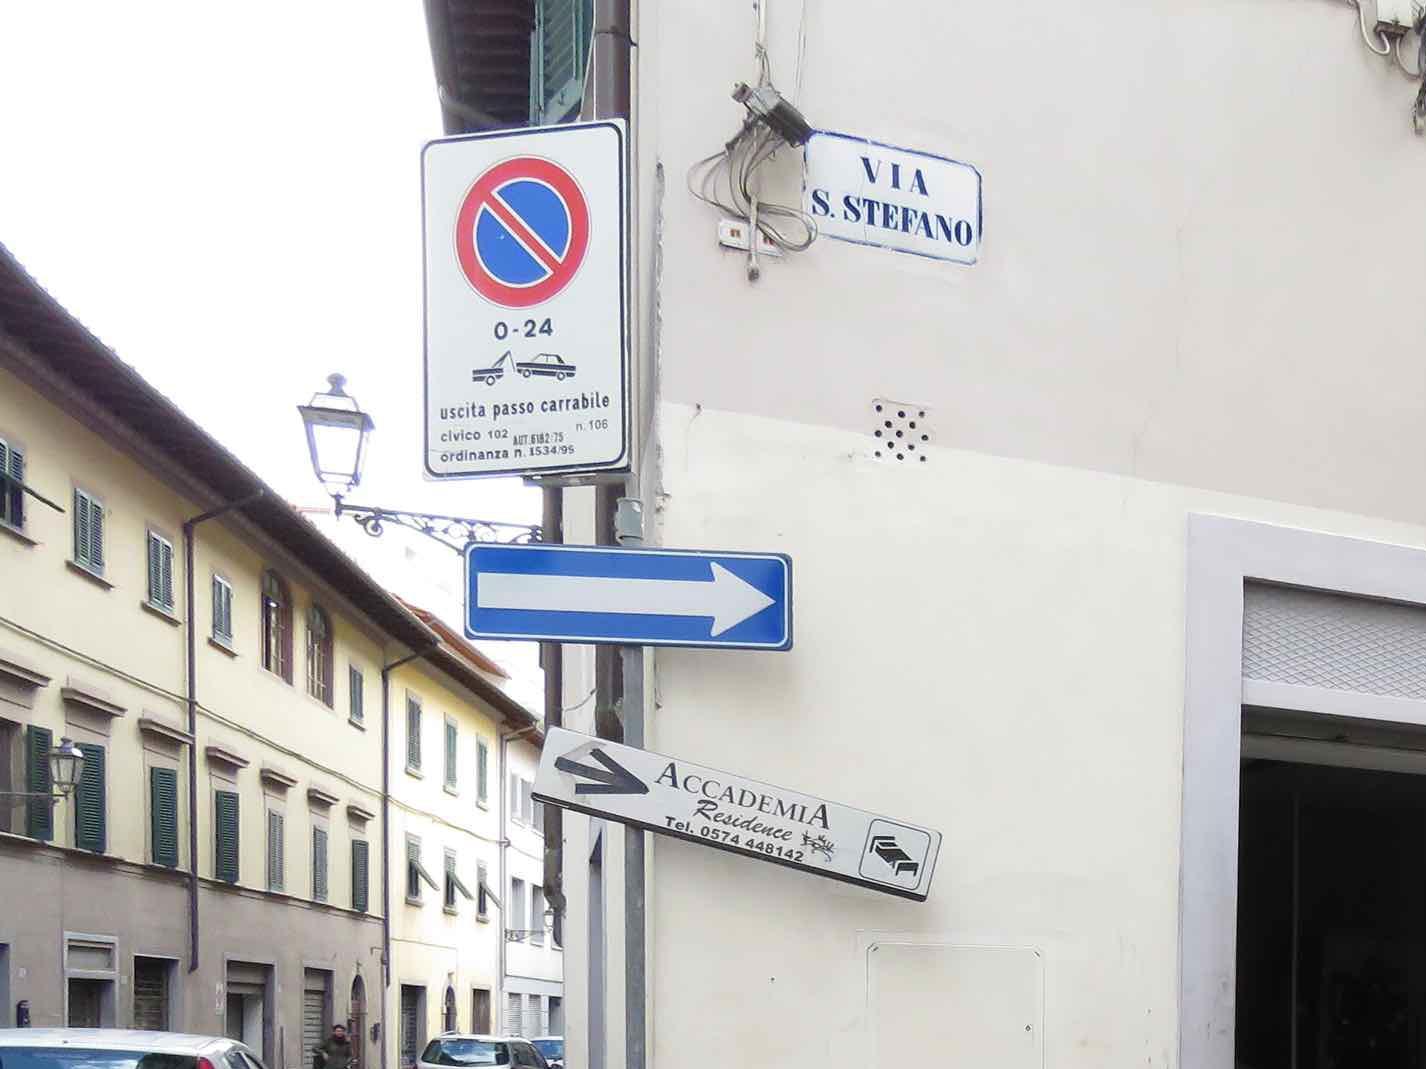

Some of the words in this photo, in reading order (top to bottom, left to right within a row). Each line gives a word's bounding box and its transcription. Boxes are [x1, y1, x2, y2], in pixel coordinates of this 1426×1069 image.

[860, 156, 929, 197] VIA
[811, 188, 835, 219] S.
[843, 194, 973, 247] STEFANO
[440, 402, 486, 420] uscita
[493, 401, 535, 421] passo
[540, 391, 610, 413] carrabile
[588, 418, 609, 431] 106
[440, 429, 481, 443] civico
[487, 429, 509, 440] 102
[440, 448, 509, 463] ordinanza
[654, 762, 830, 831] ACCADEMIA
[665, 815, 694, 834] Tel.
[700, 826, 741, 846] 0574
[745, 838, 805, 862] 448142
[692, 799, 793, 841] Residence
